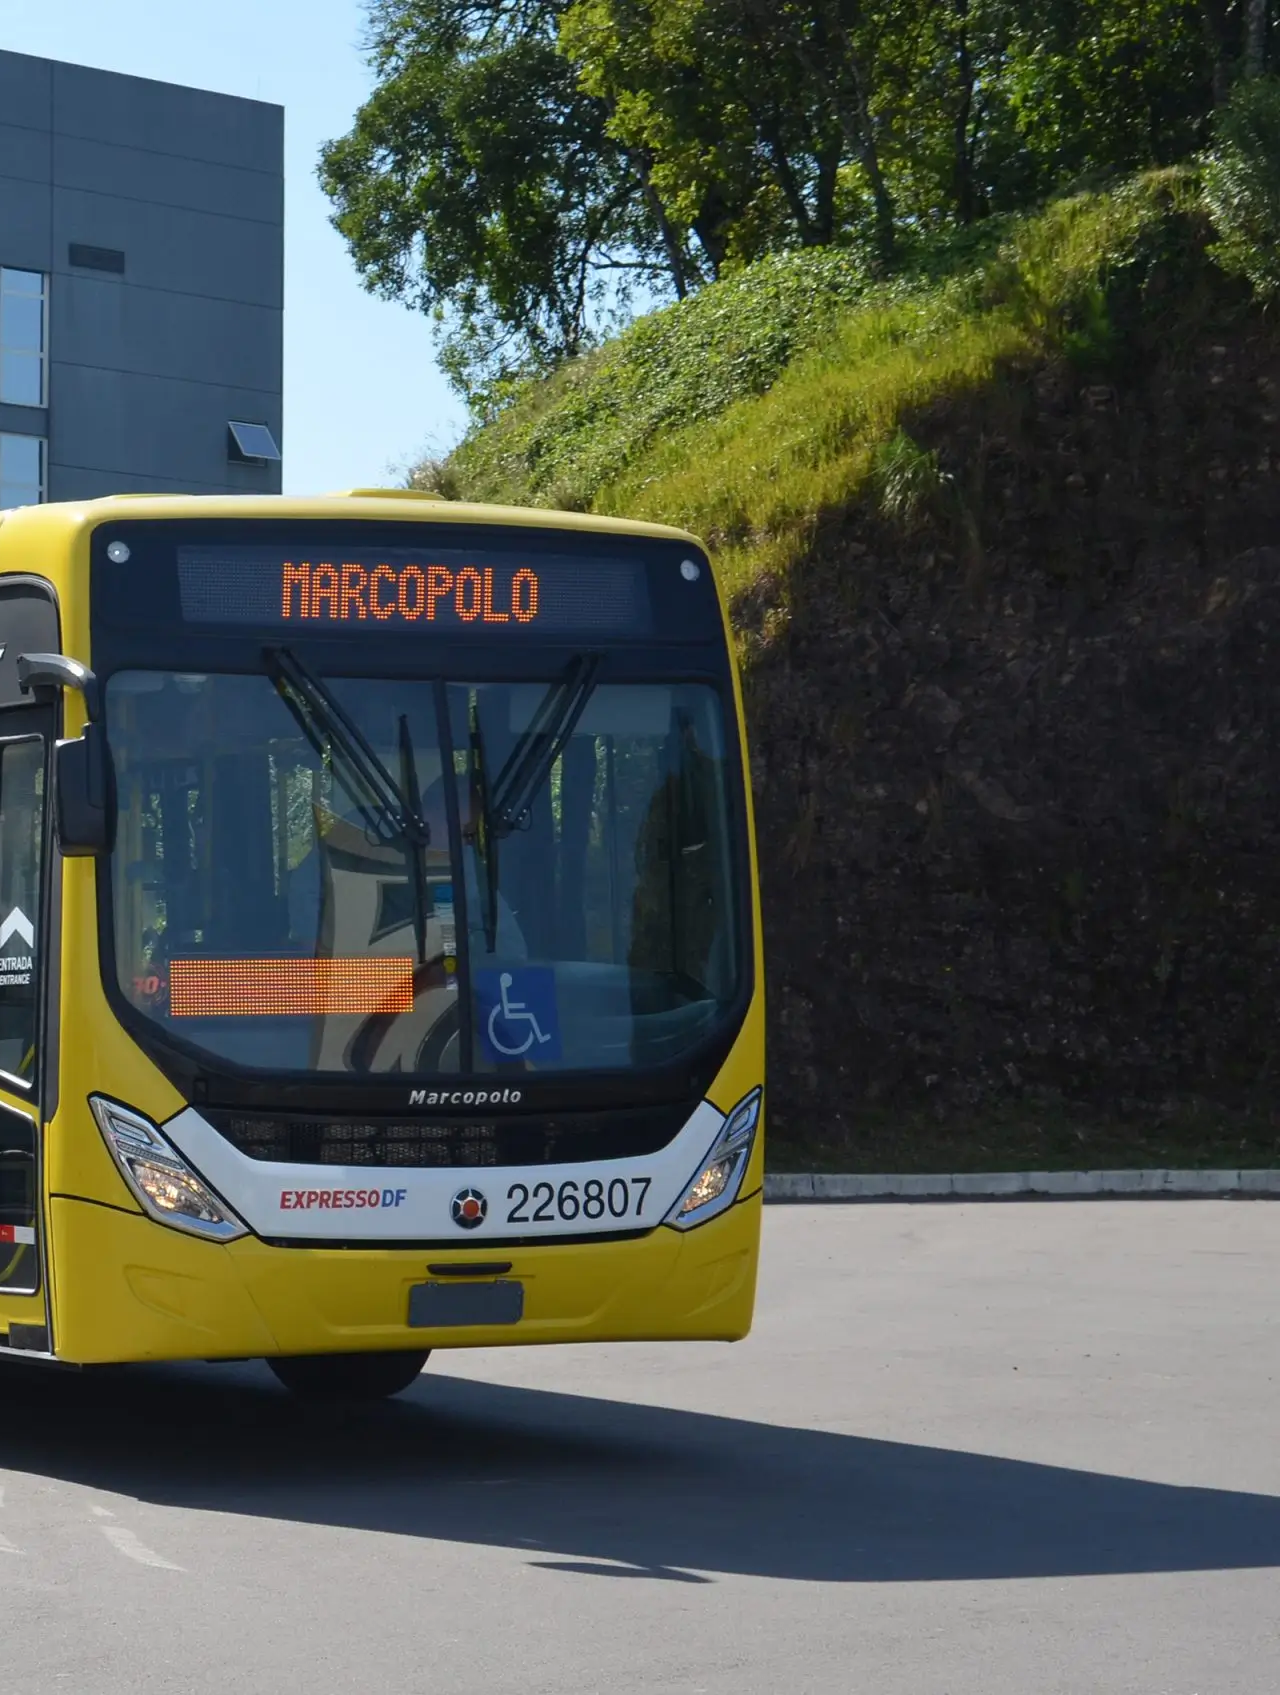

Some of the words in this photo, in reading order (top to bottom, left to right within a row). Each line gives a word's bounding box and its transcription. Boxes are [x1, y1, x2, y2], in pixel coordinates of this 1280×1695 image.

[281, 561, 539, 623] MARCOPOLO
[408, 1088, 522, 1105] Marcopolo
[506, 1176, 653, 1224] 226807
